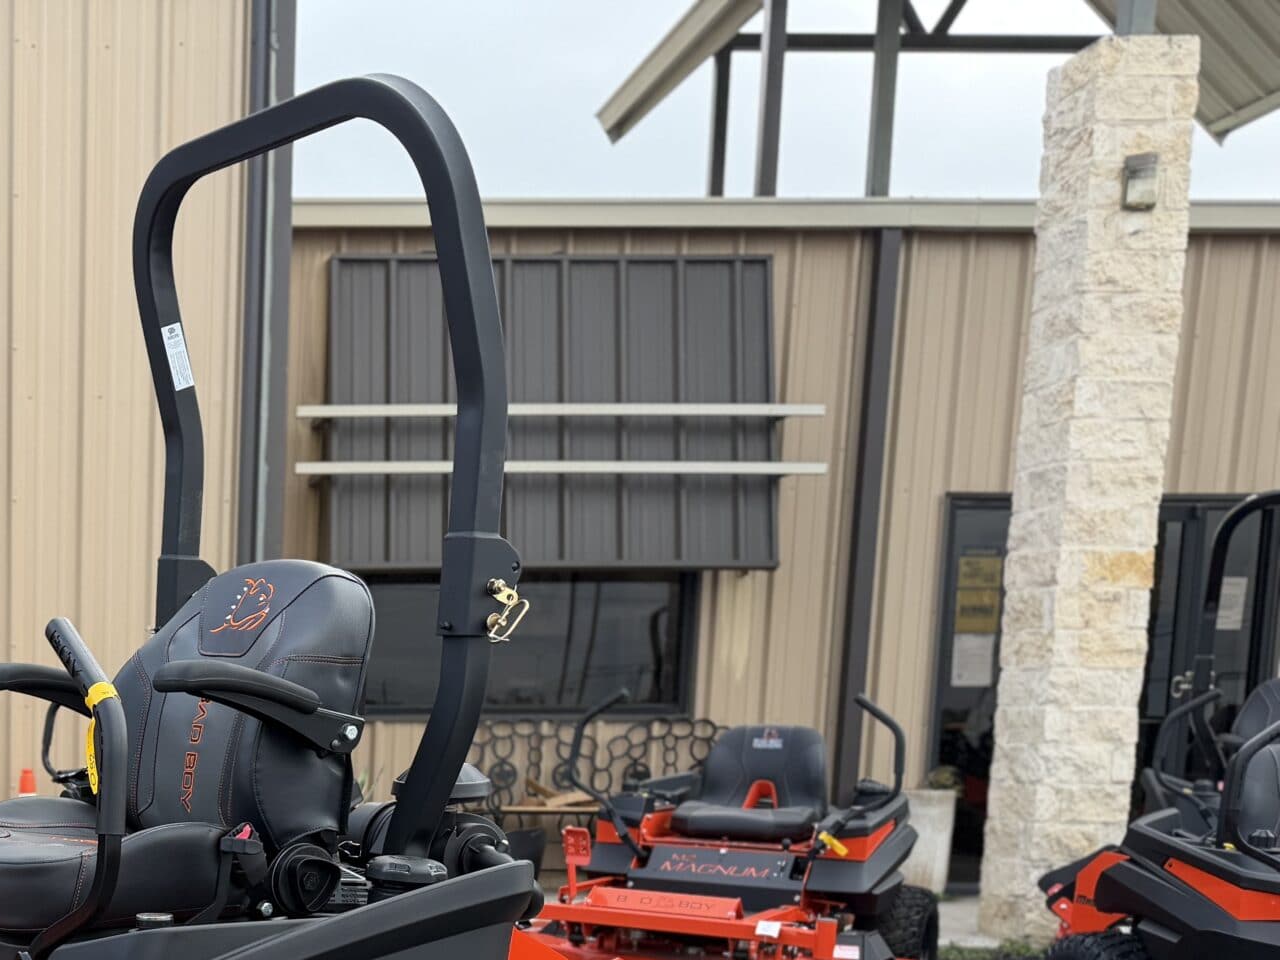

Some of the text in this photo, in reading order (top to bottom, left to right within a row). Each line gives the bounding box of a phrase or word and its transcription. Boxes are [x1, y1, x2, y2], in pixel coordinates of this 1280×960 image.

[180, 751, 199, 814] BOY
[659, 860, 770, 879] MAGNUM
[678, 900, 713, 911] BOY
